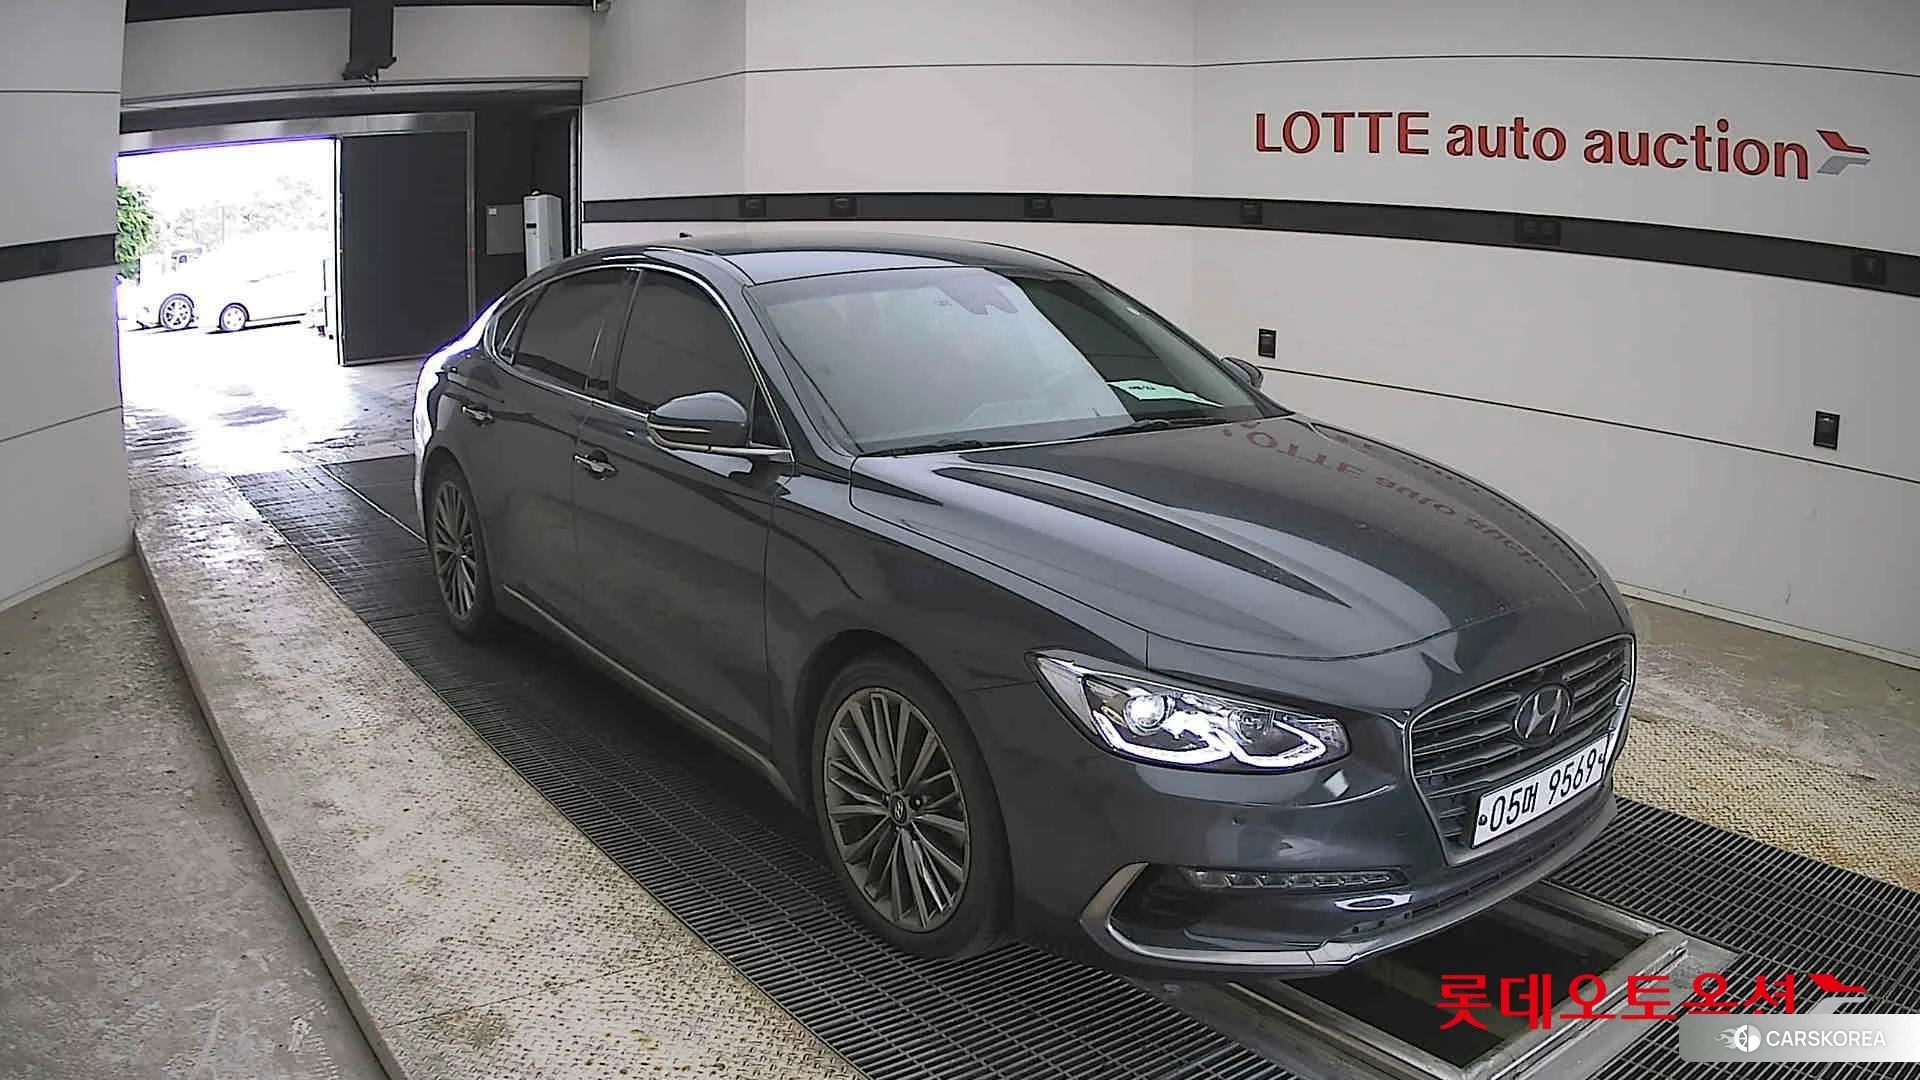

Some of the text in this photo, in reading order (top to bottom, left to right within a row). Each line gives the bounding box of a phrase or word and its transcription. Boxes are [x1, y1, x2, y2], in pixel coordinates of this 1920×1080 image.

[1255, 111, 1810, 180] LOTTE auto auction
[1490, 749, 1597, 832] 05머 9569
